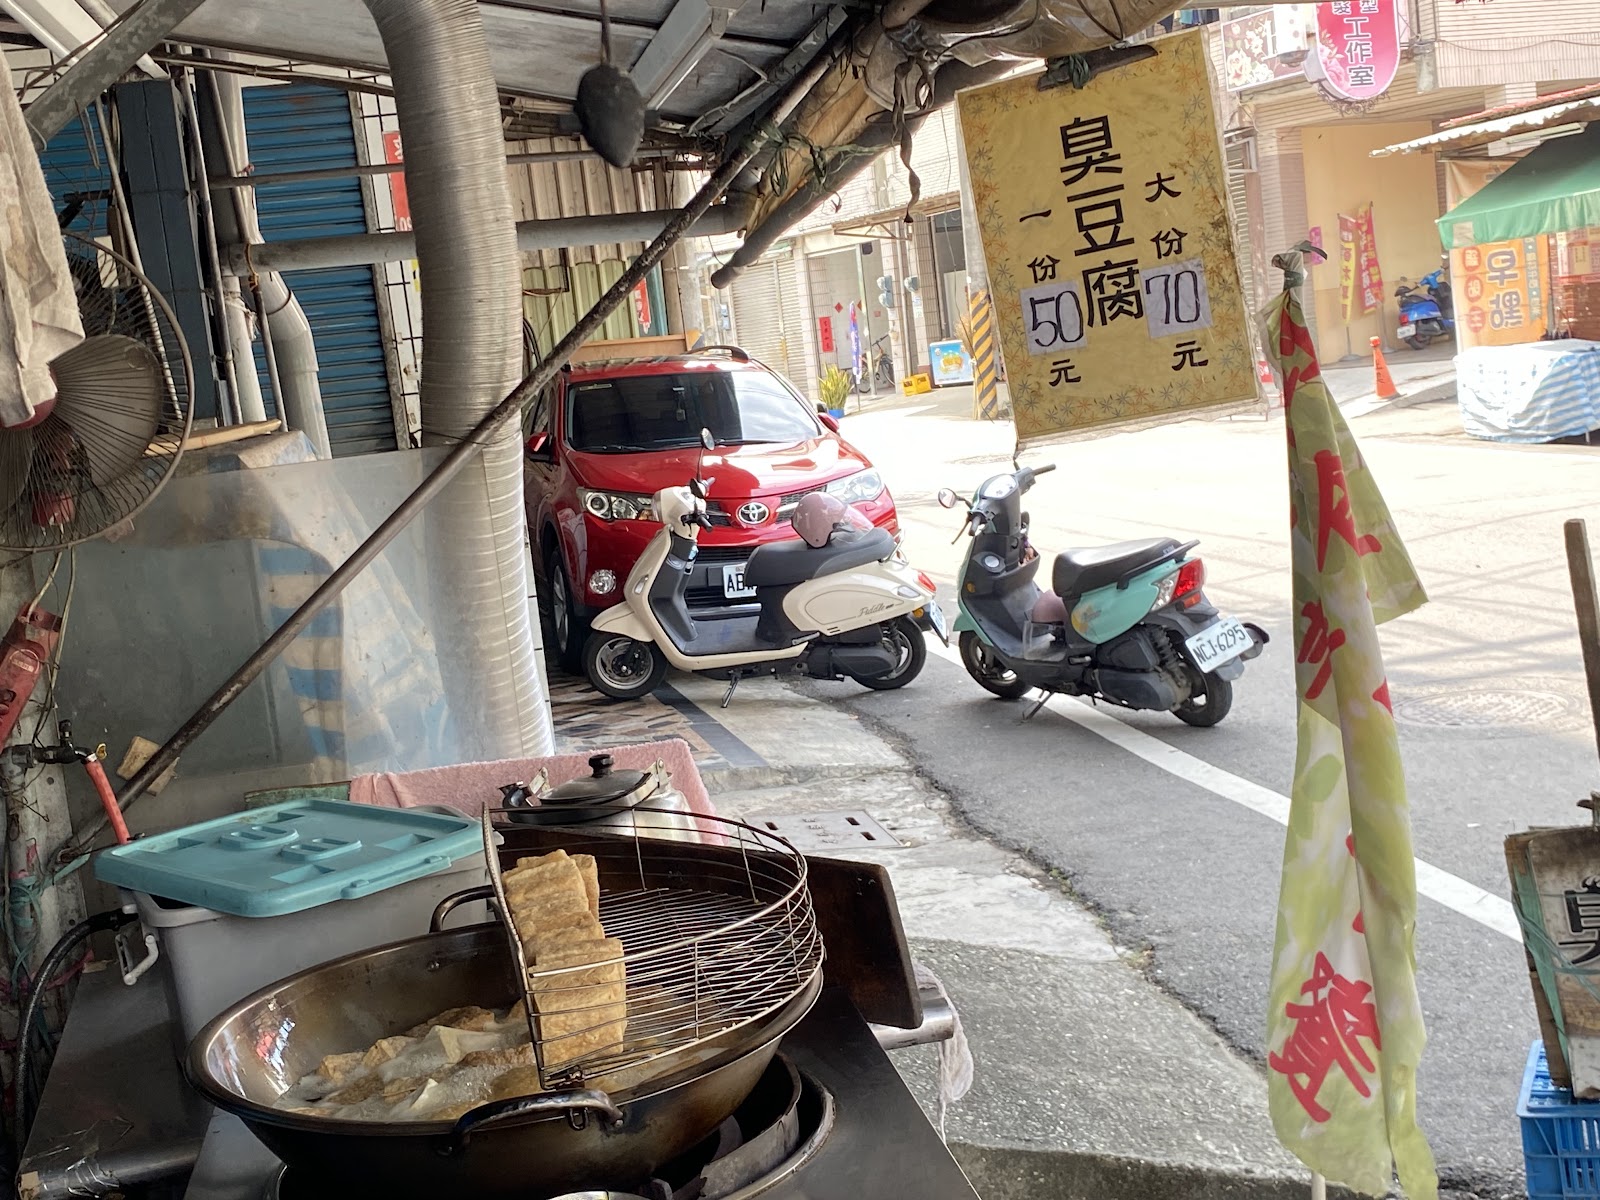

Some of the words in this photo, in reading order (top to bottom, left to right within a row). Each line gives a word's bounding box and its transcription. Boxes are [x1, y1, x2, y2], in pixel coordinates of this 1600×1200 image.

[1345, 18, 1375, 87] 工作室
[1060, 115, 1144, 328] 臭豆腐
[1145, 172, 1188, 259] 大份
[1019, 209, 1060, 283] 一份
[1029, 290, 1084, 347] 50
[1145, 270, 1200, 324] 70
[1049, 359, 1081, 387] 元
[1172, 340, 1209, 371] 元
[1192, 624, 1246, 665] NCJ-6295
